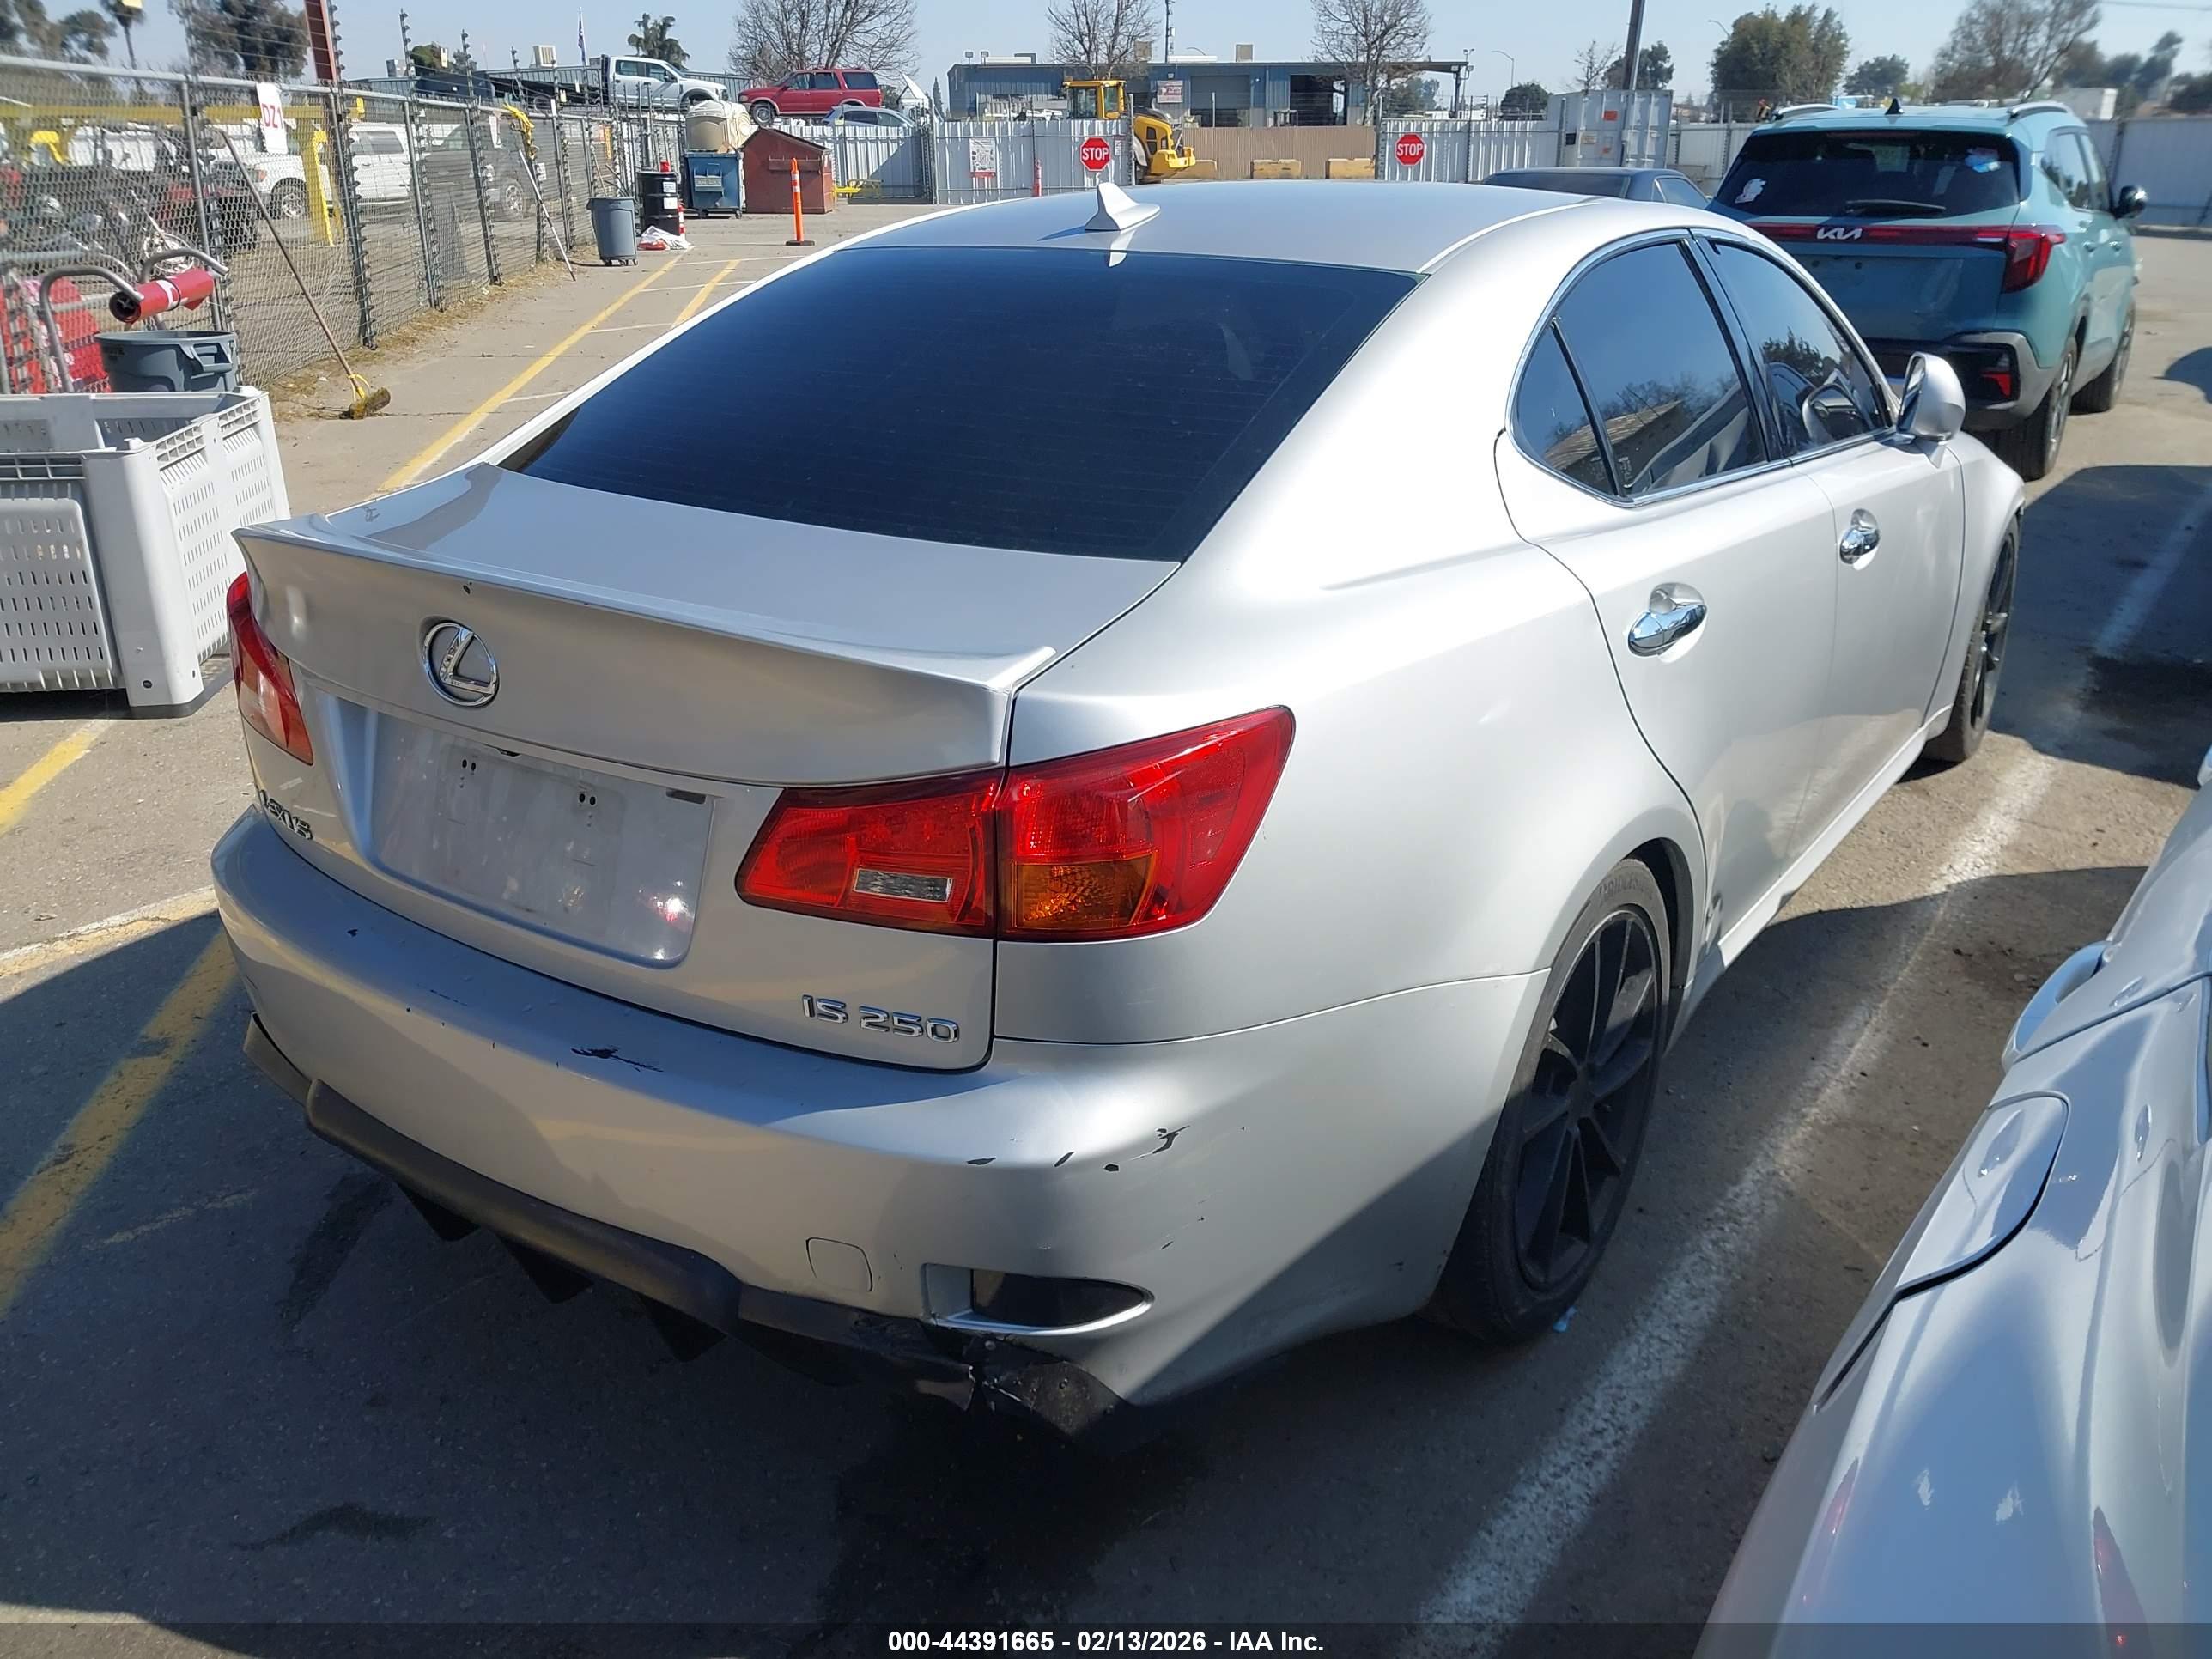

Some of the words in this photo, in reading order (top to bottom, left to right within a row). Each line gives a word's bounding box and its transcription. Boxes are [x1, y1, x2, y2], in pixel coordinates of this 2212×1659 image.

[261, 103, 283, 129] DZ1
[1082, 148, 1109, 161] STOP
[1396, 143, 1424, 156] STOP
[1816, 227, 1863, 240] KIA
[802, 994, 848, 1024] IS
[859, 1005, 960, 1043] 250
